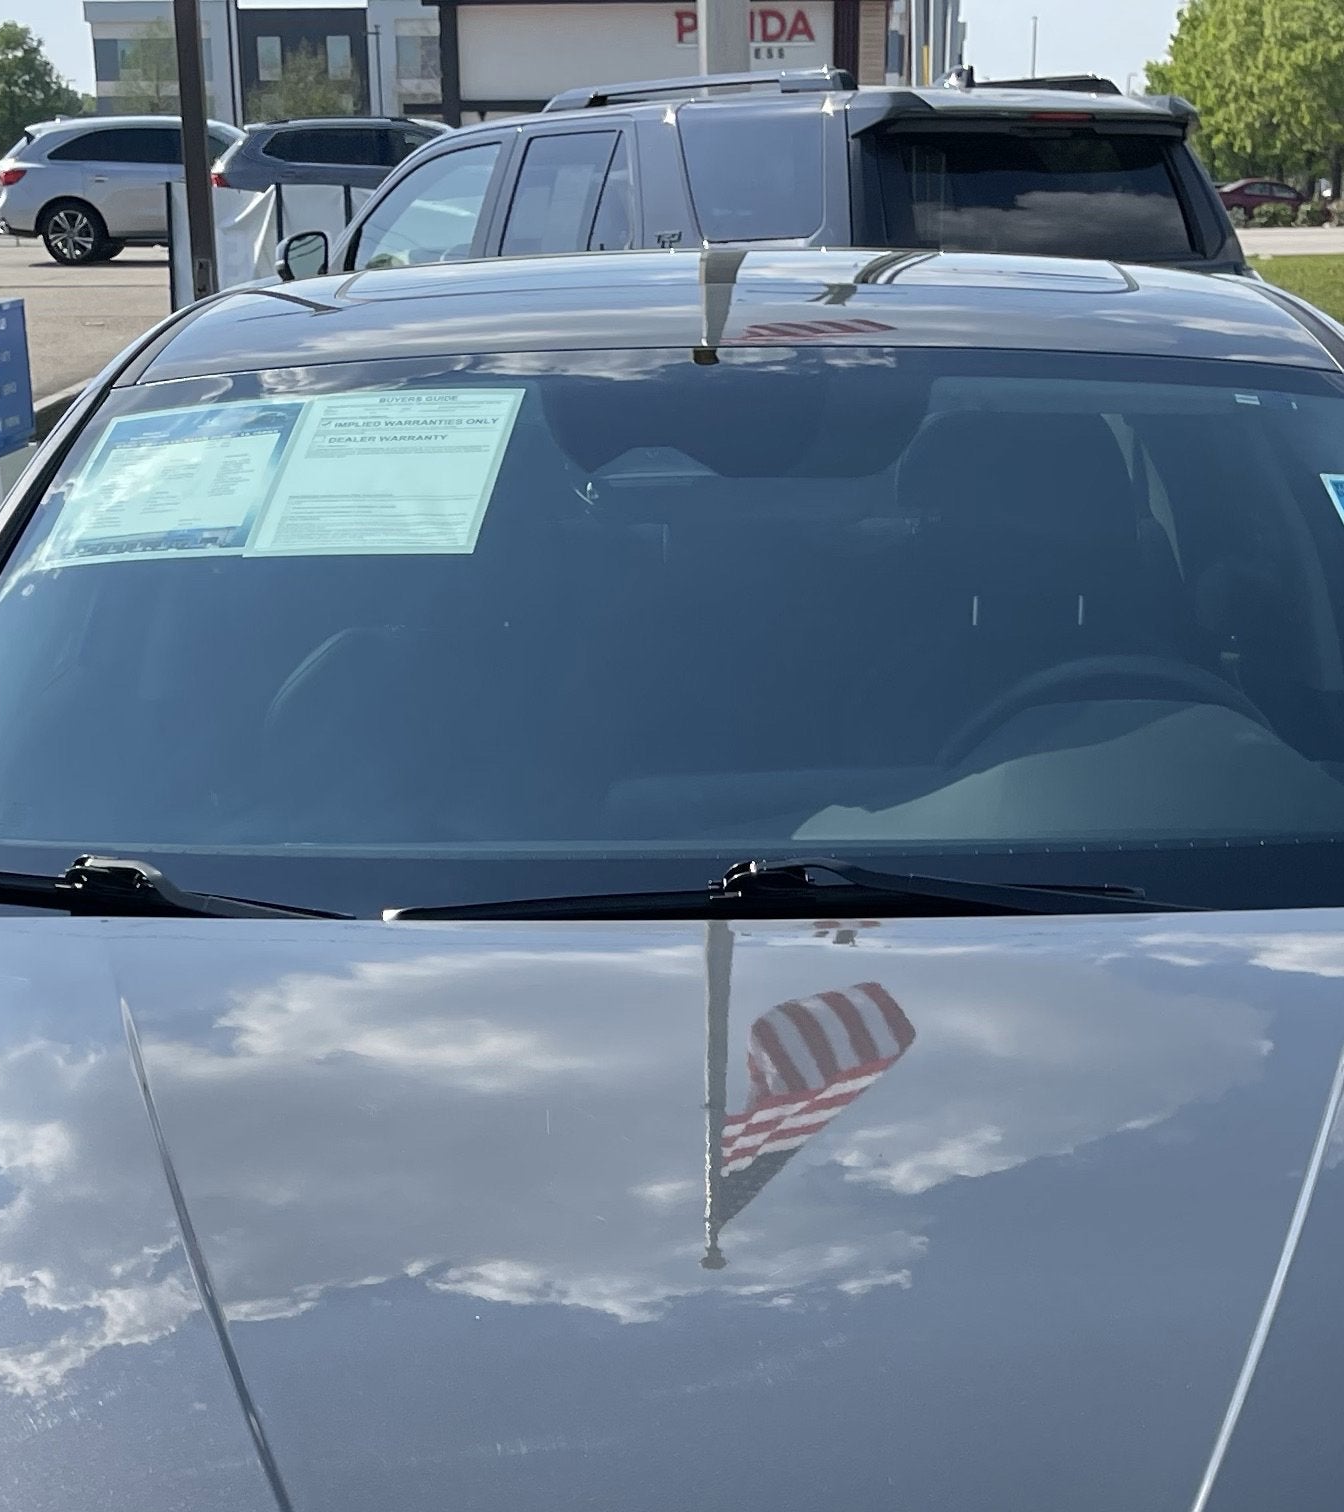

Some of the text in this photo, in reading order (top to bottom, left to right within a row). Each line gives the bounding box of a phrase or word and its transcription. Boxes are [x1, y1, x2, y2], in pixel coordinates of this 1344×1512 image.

[674, 9, 816, 43] PDA
[379, 396, 422, 404] BUYERS
[333, 417, 501, 429] IMPLIED WARRANTIES ONLY
[328, 433, 449, 444] DEALER WARRANTY
